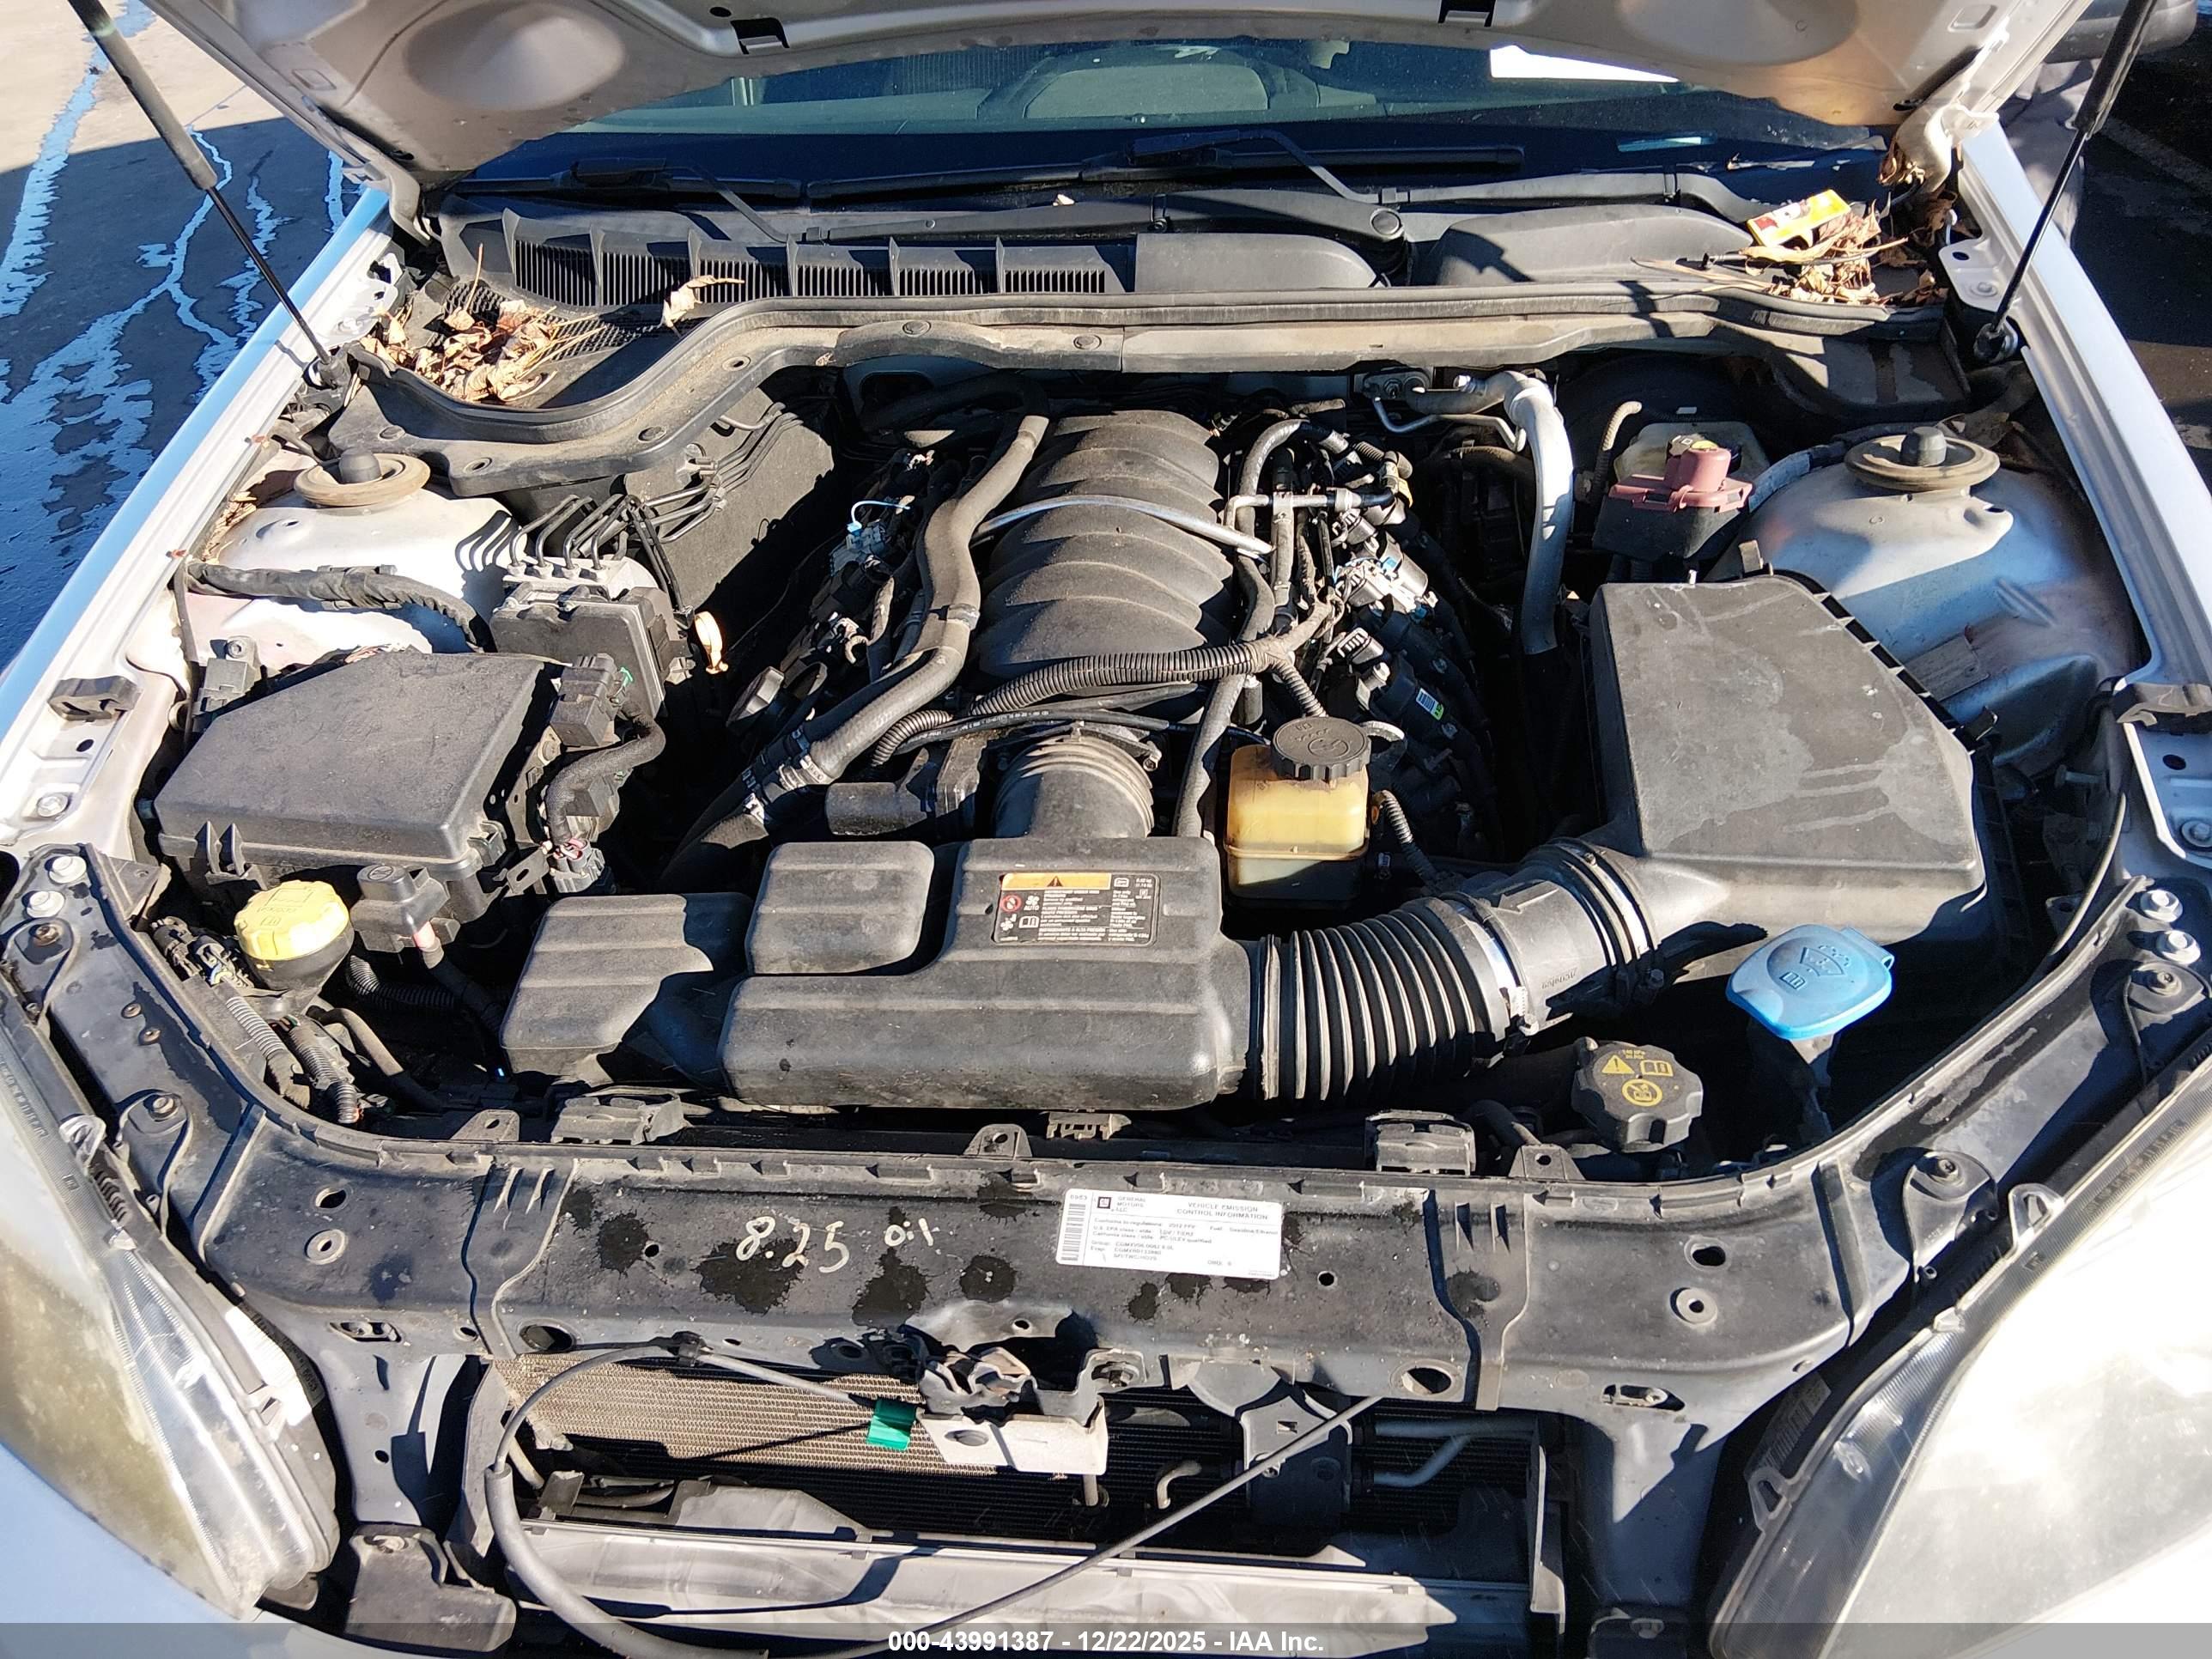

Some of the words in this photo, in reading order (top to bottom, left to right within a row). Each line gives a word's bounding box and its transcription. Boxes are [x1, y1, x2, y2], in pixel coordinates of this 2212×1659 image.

[1221, 1203, 1258, 1212] EMISSION
[1215, 1211, 1268, 1220] INFORMATION
[736, 1216, 850, 1273] 8.25
